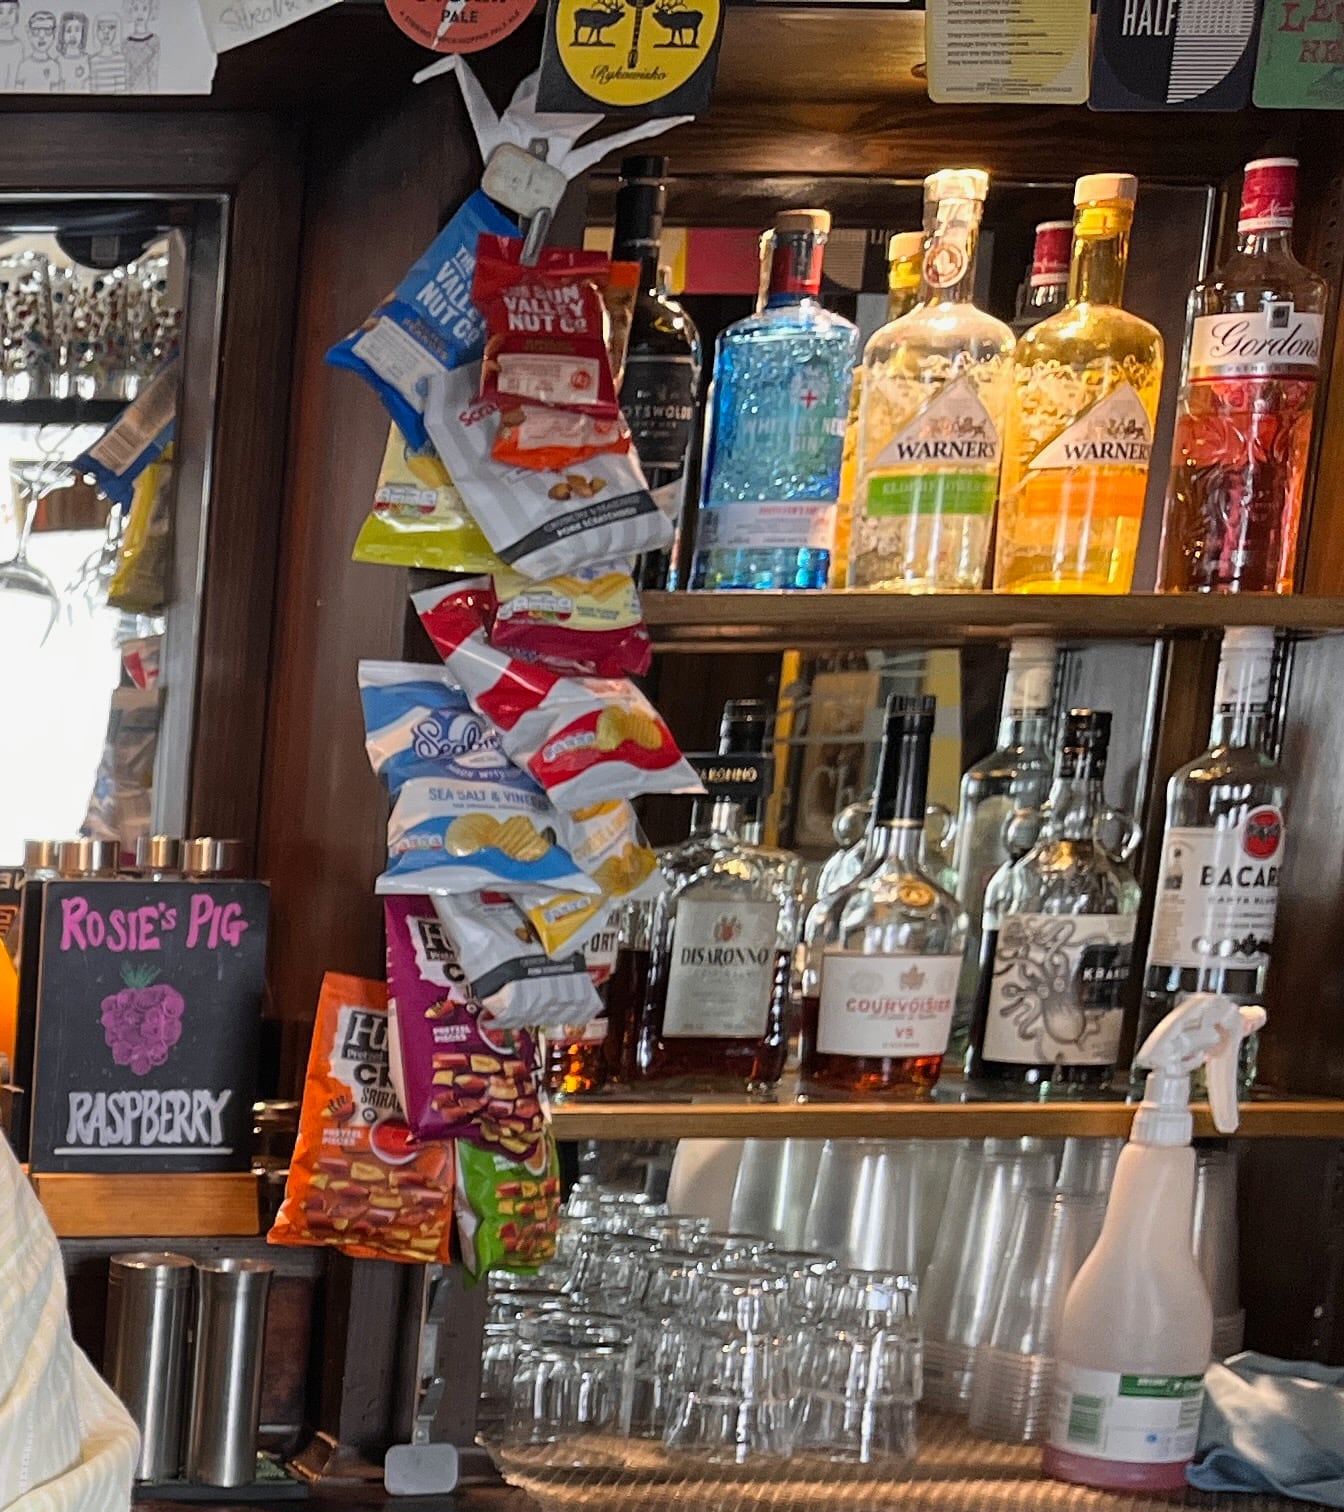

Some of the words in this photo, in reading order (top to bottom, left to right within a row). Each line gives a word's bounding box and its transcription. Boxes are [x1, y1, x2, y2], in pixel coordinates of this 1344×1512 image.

[509, 313, 555, 332] NUT
[185, 893, 249, 950] PIG
[680, 945, 771, 966] DISARONNO
[66, 1088, 233, 1147] RASPBERRY
